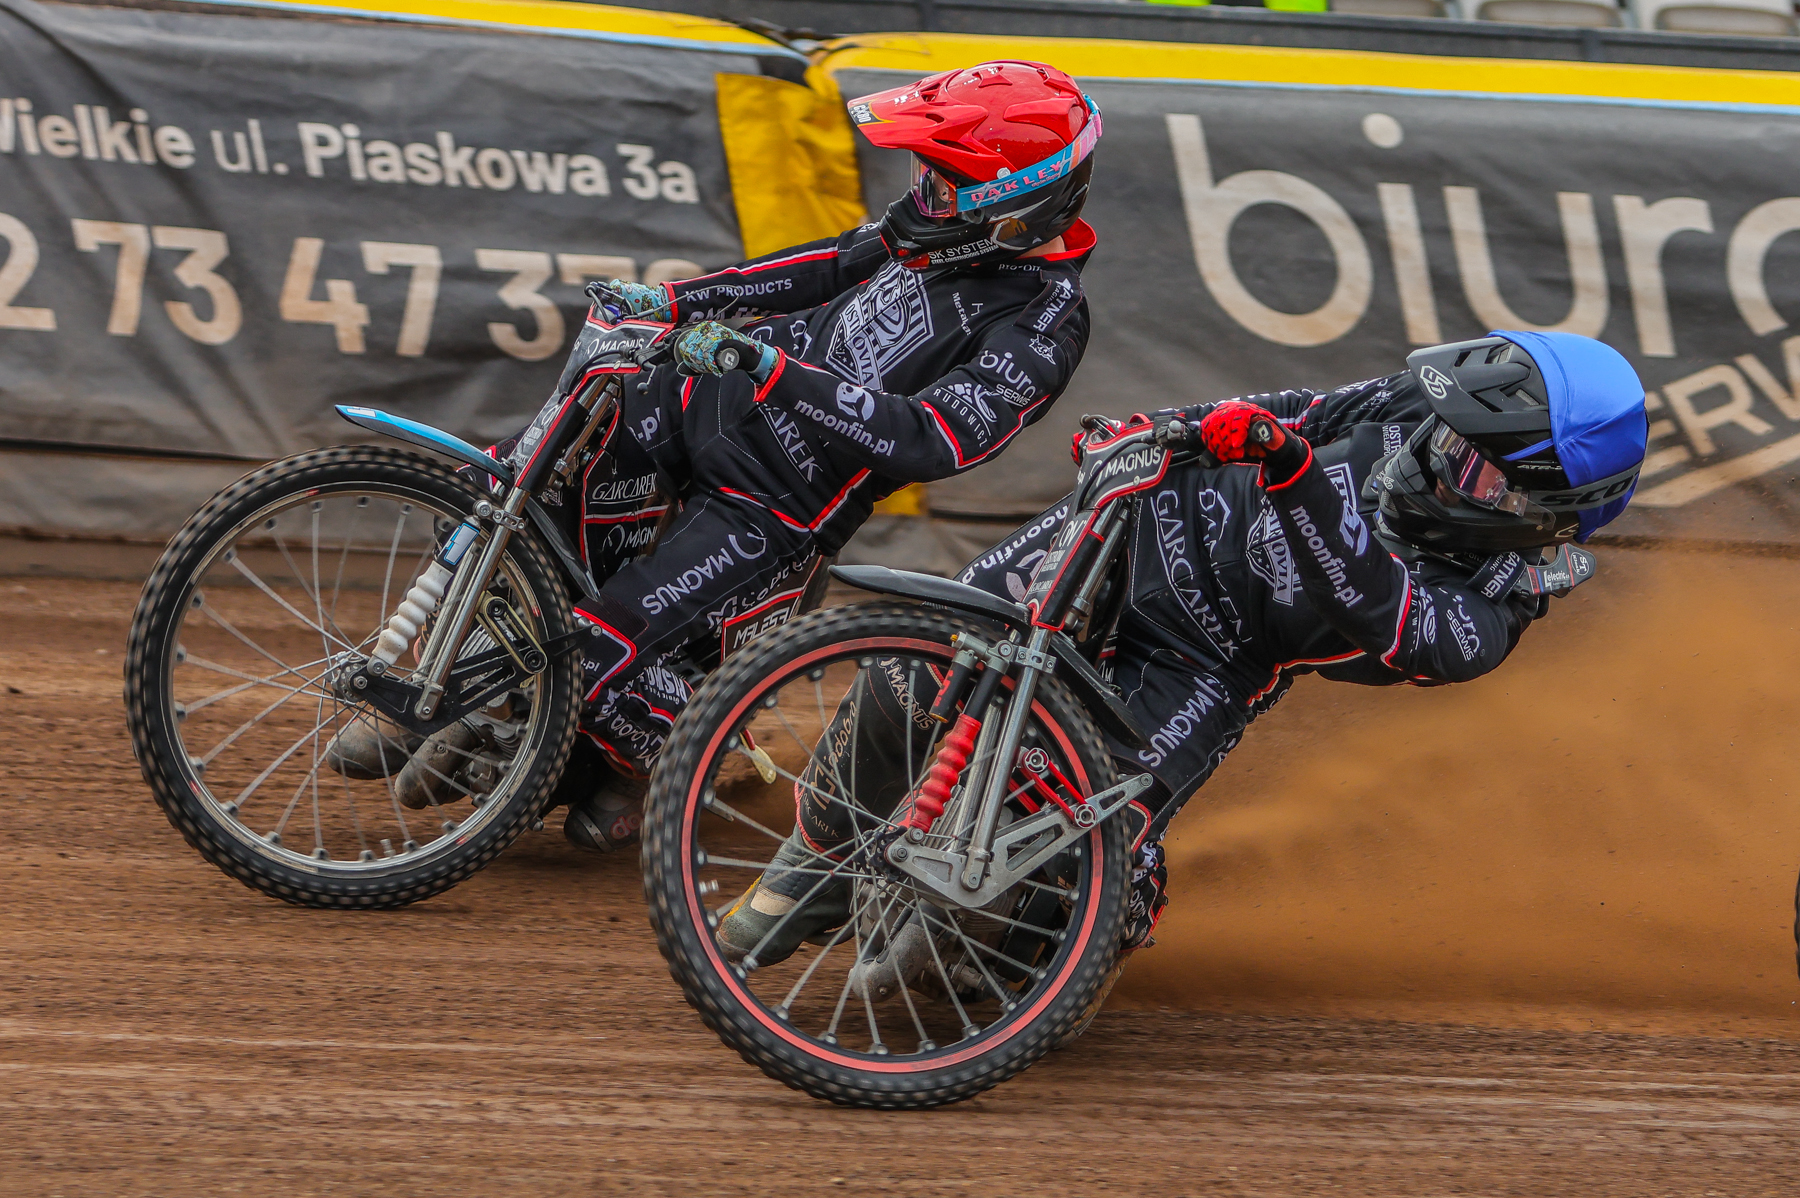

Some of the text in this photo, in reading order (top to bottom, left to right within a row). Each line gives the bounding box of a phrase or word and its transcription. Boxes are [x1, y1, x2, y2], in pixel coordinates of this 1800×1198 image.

[211, 118, 288, 174] ul.
[299, 121, 610, 197] Piaskowa
[616, 143, 698, 203] 3a
[971, 161, 1061, 202] OAKLEY
[927, 250, 945, 260] SK
[72, 217, 241, 345] 73
[281, 236, 442, 357] 47
[685, 278, 793, 302] KW PRODUCTS
[795, 400, 896, 457] moonfin.pl
[592, 472, 658, 500] GARCAREK
[1105, 445, 1161, 477] MAGNUS
[642, 547, 734, 615] MAGNUS
[1289, 505, 1364, 608] moonfin.pl
[1446, 609, 1474, 661] SERWIS
[1138, 689, 1216, 768] MAGNUS
